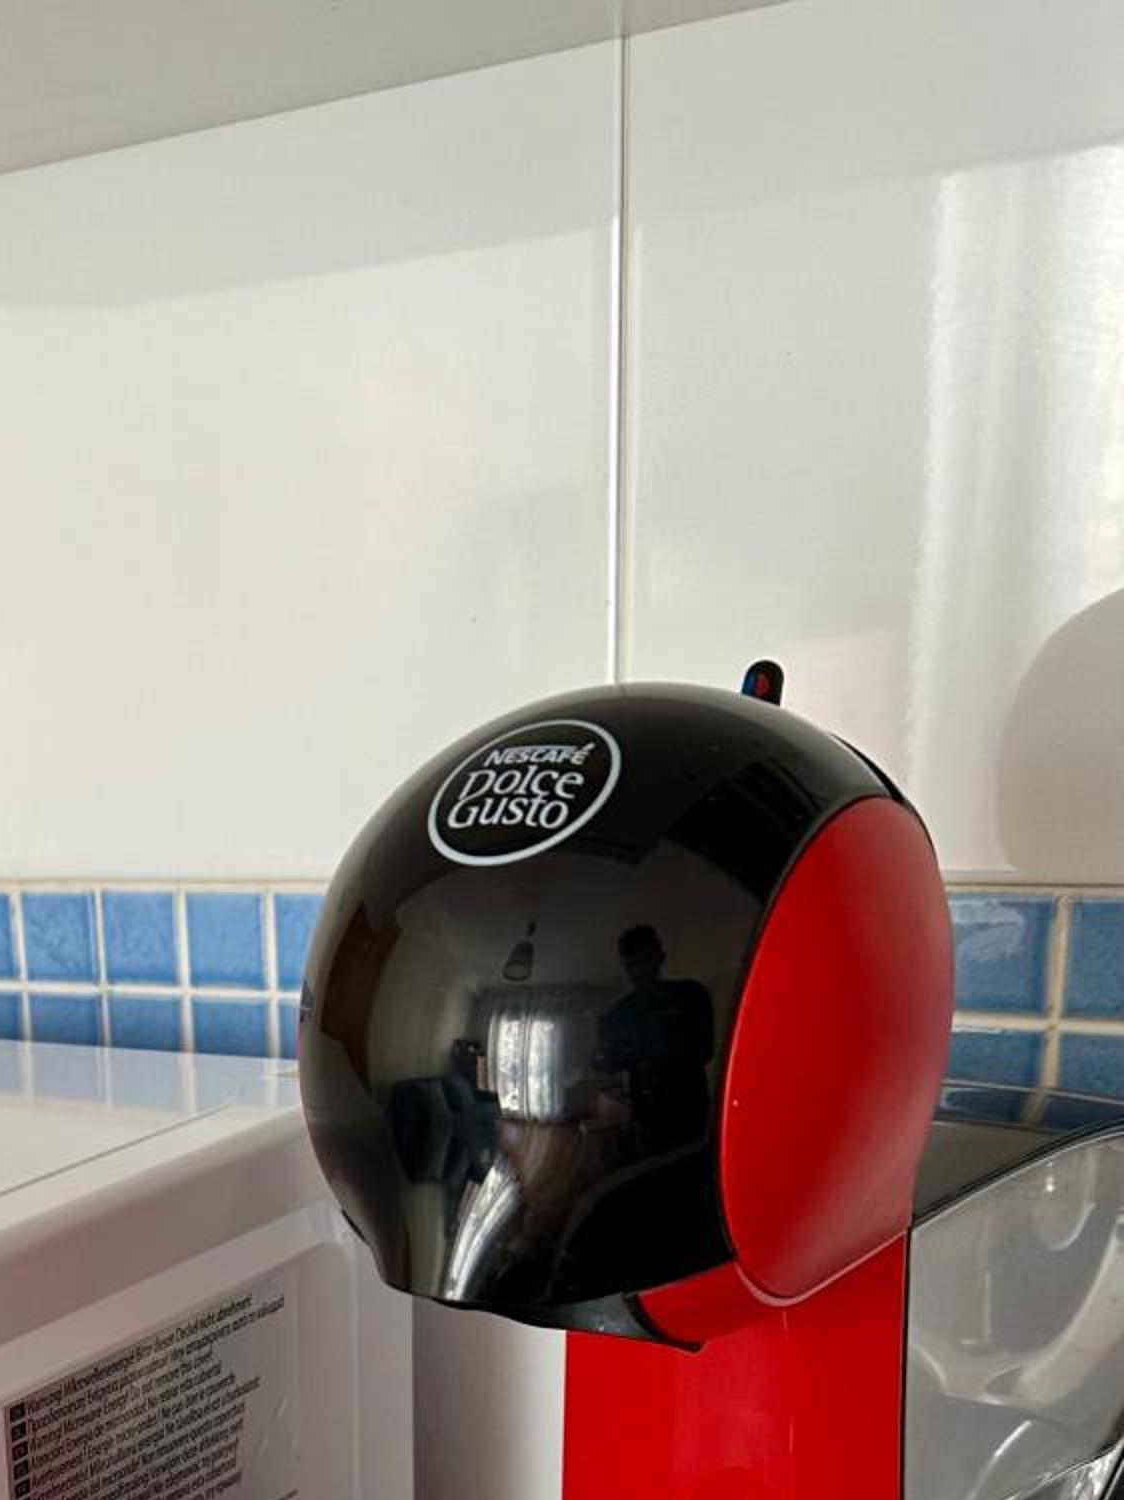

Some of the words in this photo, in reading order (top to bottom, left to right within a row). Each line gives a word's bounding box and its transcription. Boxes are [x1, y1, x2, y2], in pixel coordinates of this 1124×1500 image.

[483, 742, 596, 767] NESCAFÉ
[458, 764, 585, 801] Dolce
[446, 794, 569, 829] Gusto
